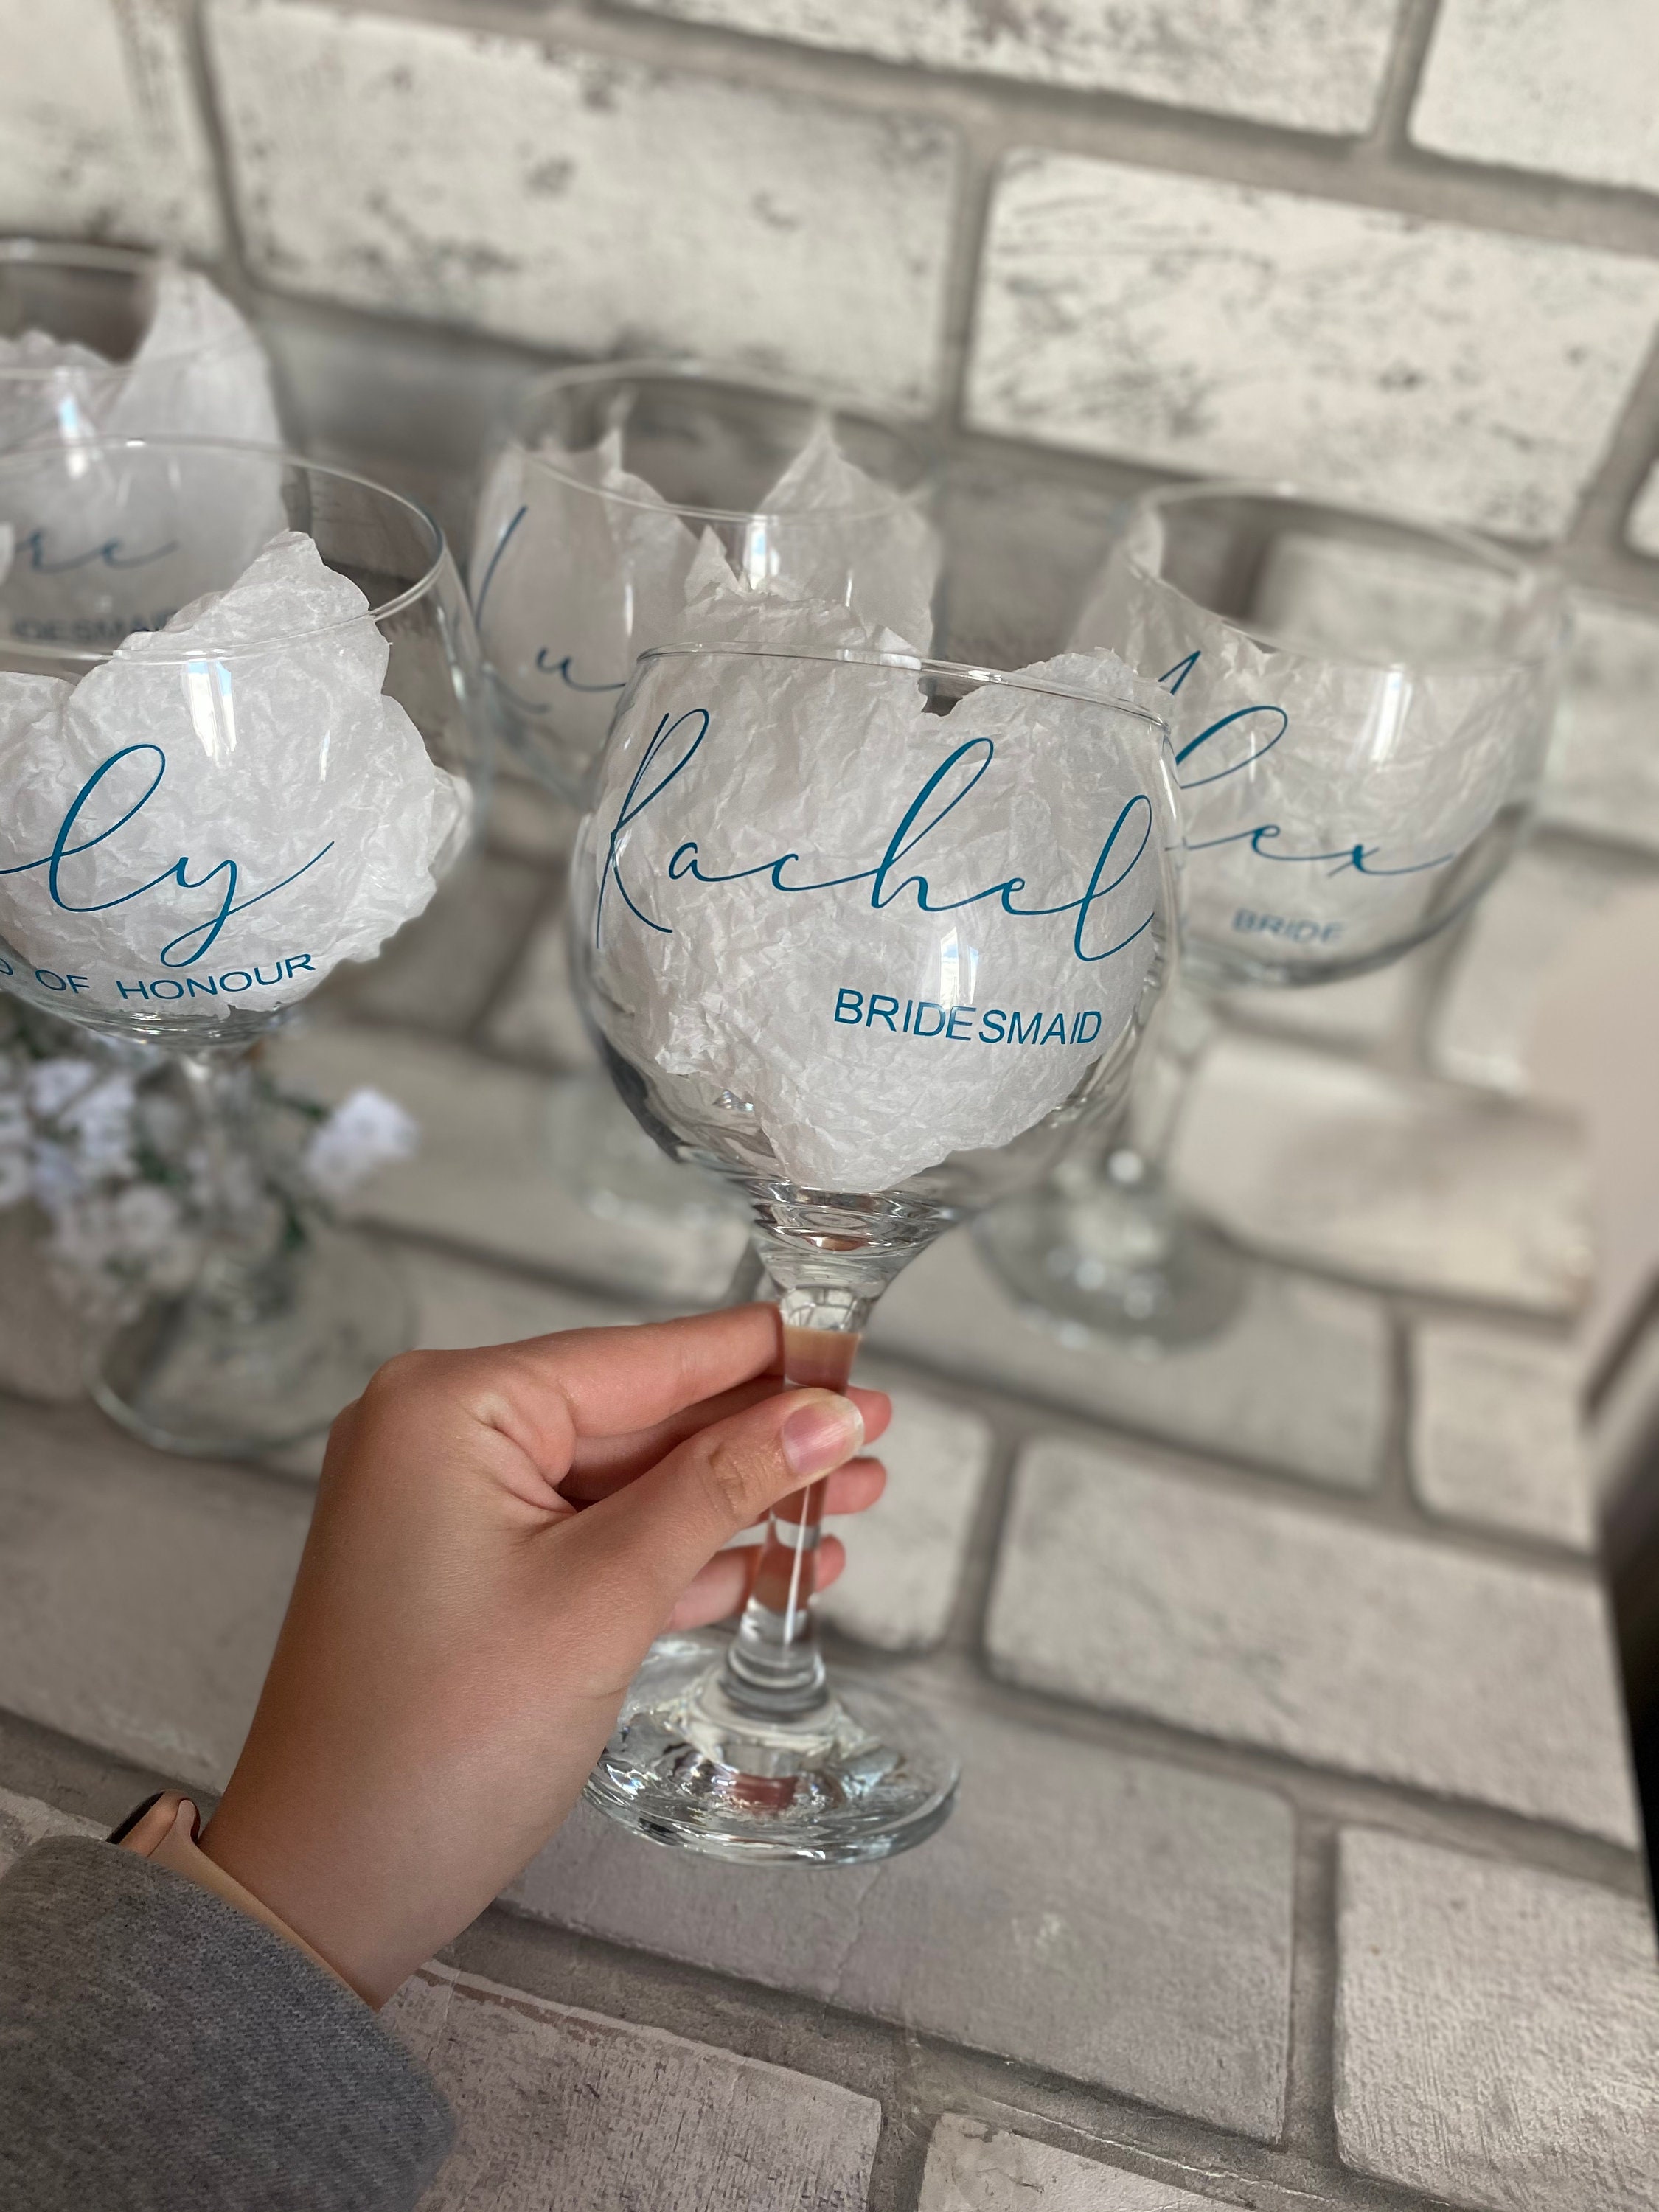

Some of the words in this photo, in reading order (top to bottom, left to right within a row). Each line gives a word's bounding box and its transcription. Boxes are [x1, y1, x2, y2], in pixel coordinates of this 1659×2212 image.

[596, 707, 1156, 961] Rachel
[1231, 908, 1346, 945] BRIDE
[35, 969, 90, 994] OF
[116, 953, 316, 1000] HONOUR
[834, 987, 1102, 1046] BRIDESMAID
